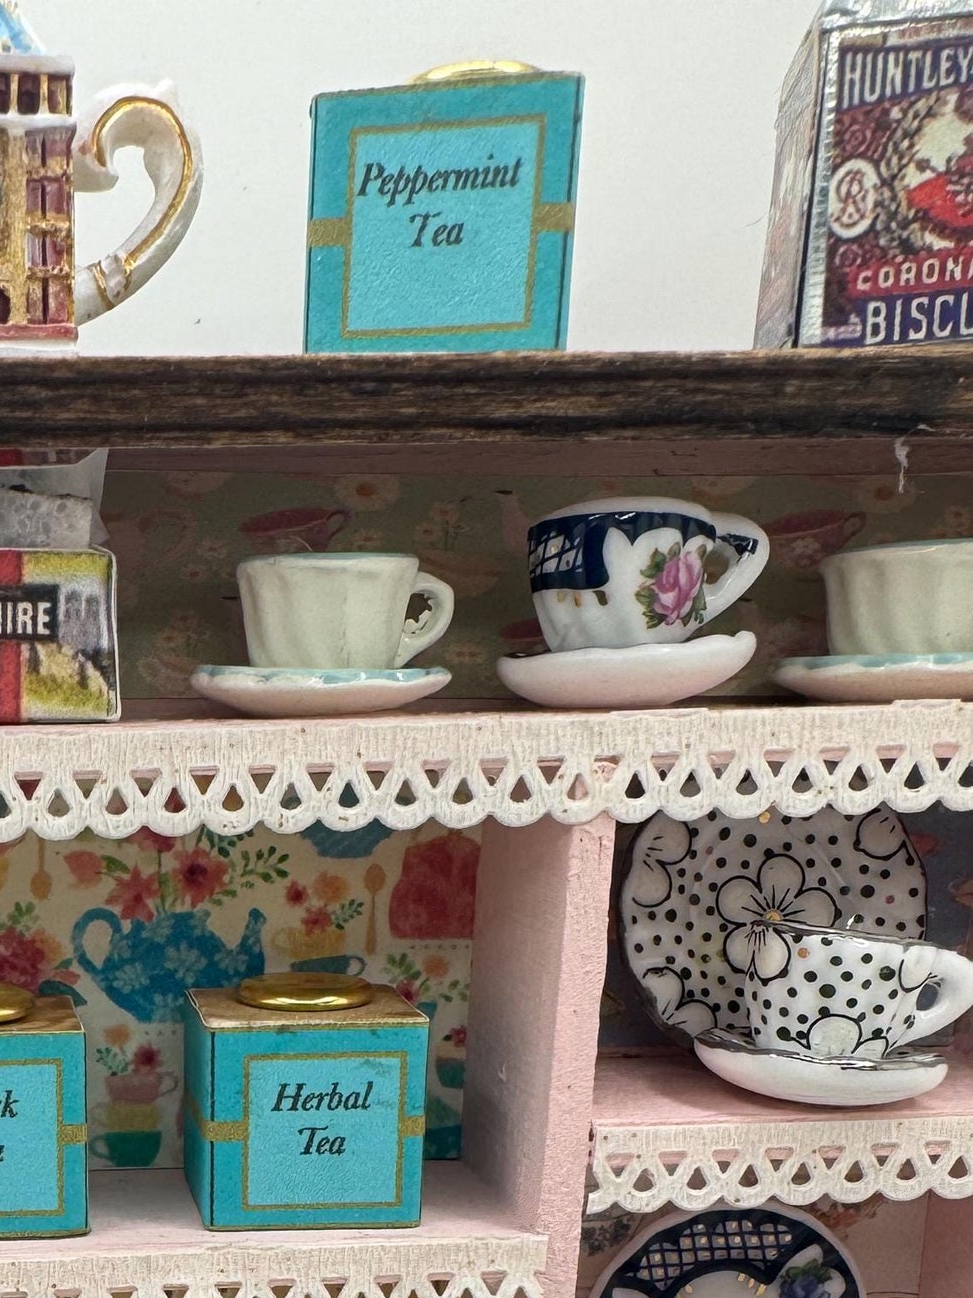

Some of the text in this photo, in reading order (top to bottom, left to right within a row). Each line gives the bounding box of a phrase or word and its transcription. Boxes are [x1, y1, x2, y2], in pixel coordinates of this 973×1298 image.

[842, 46, 973, 109] HUNTLEY
[356, 153, 524, 208] Peppermint
[408, 211, 465, 248] Tea
[271, 1080, 374, 1112] Herbal
[297, 1126, 347, 1156] Tea
